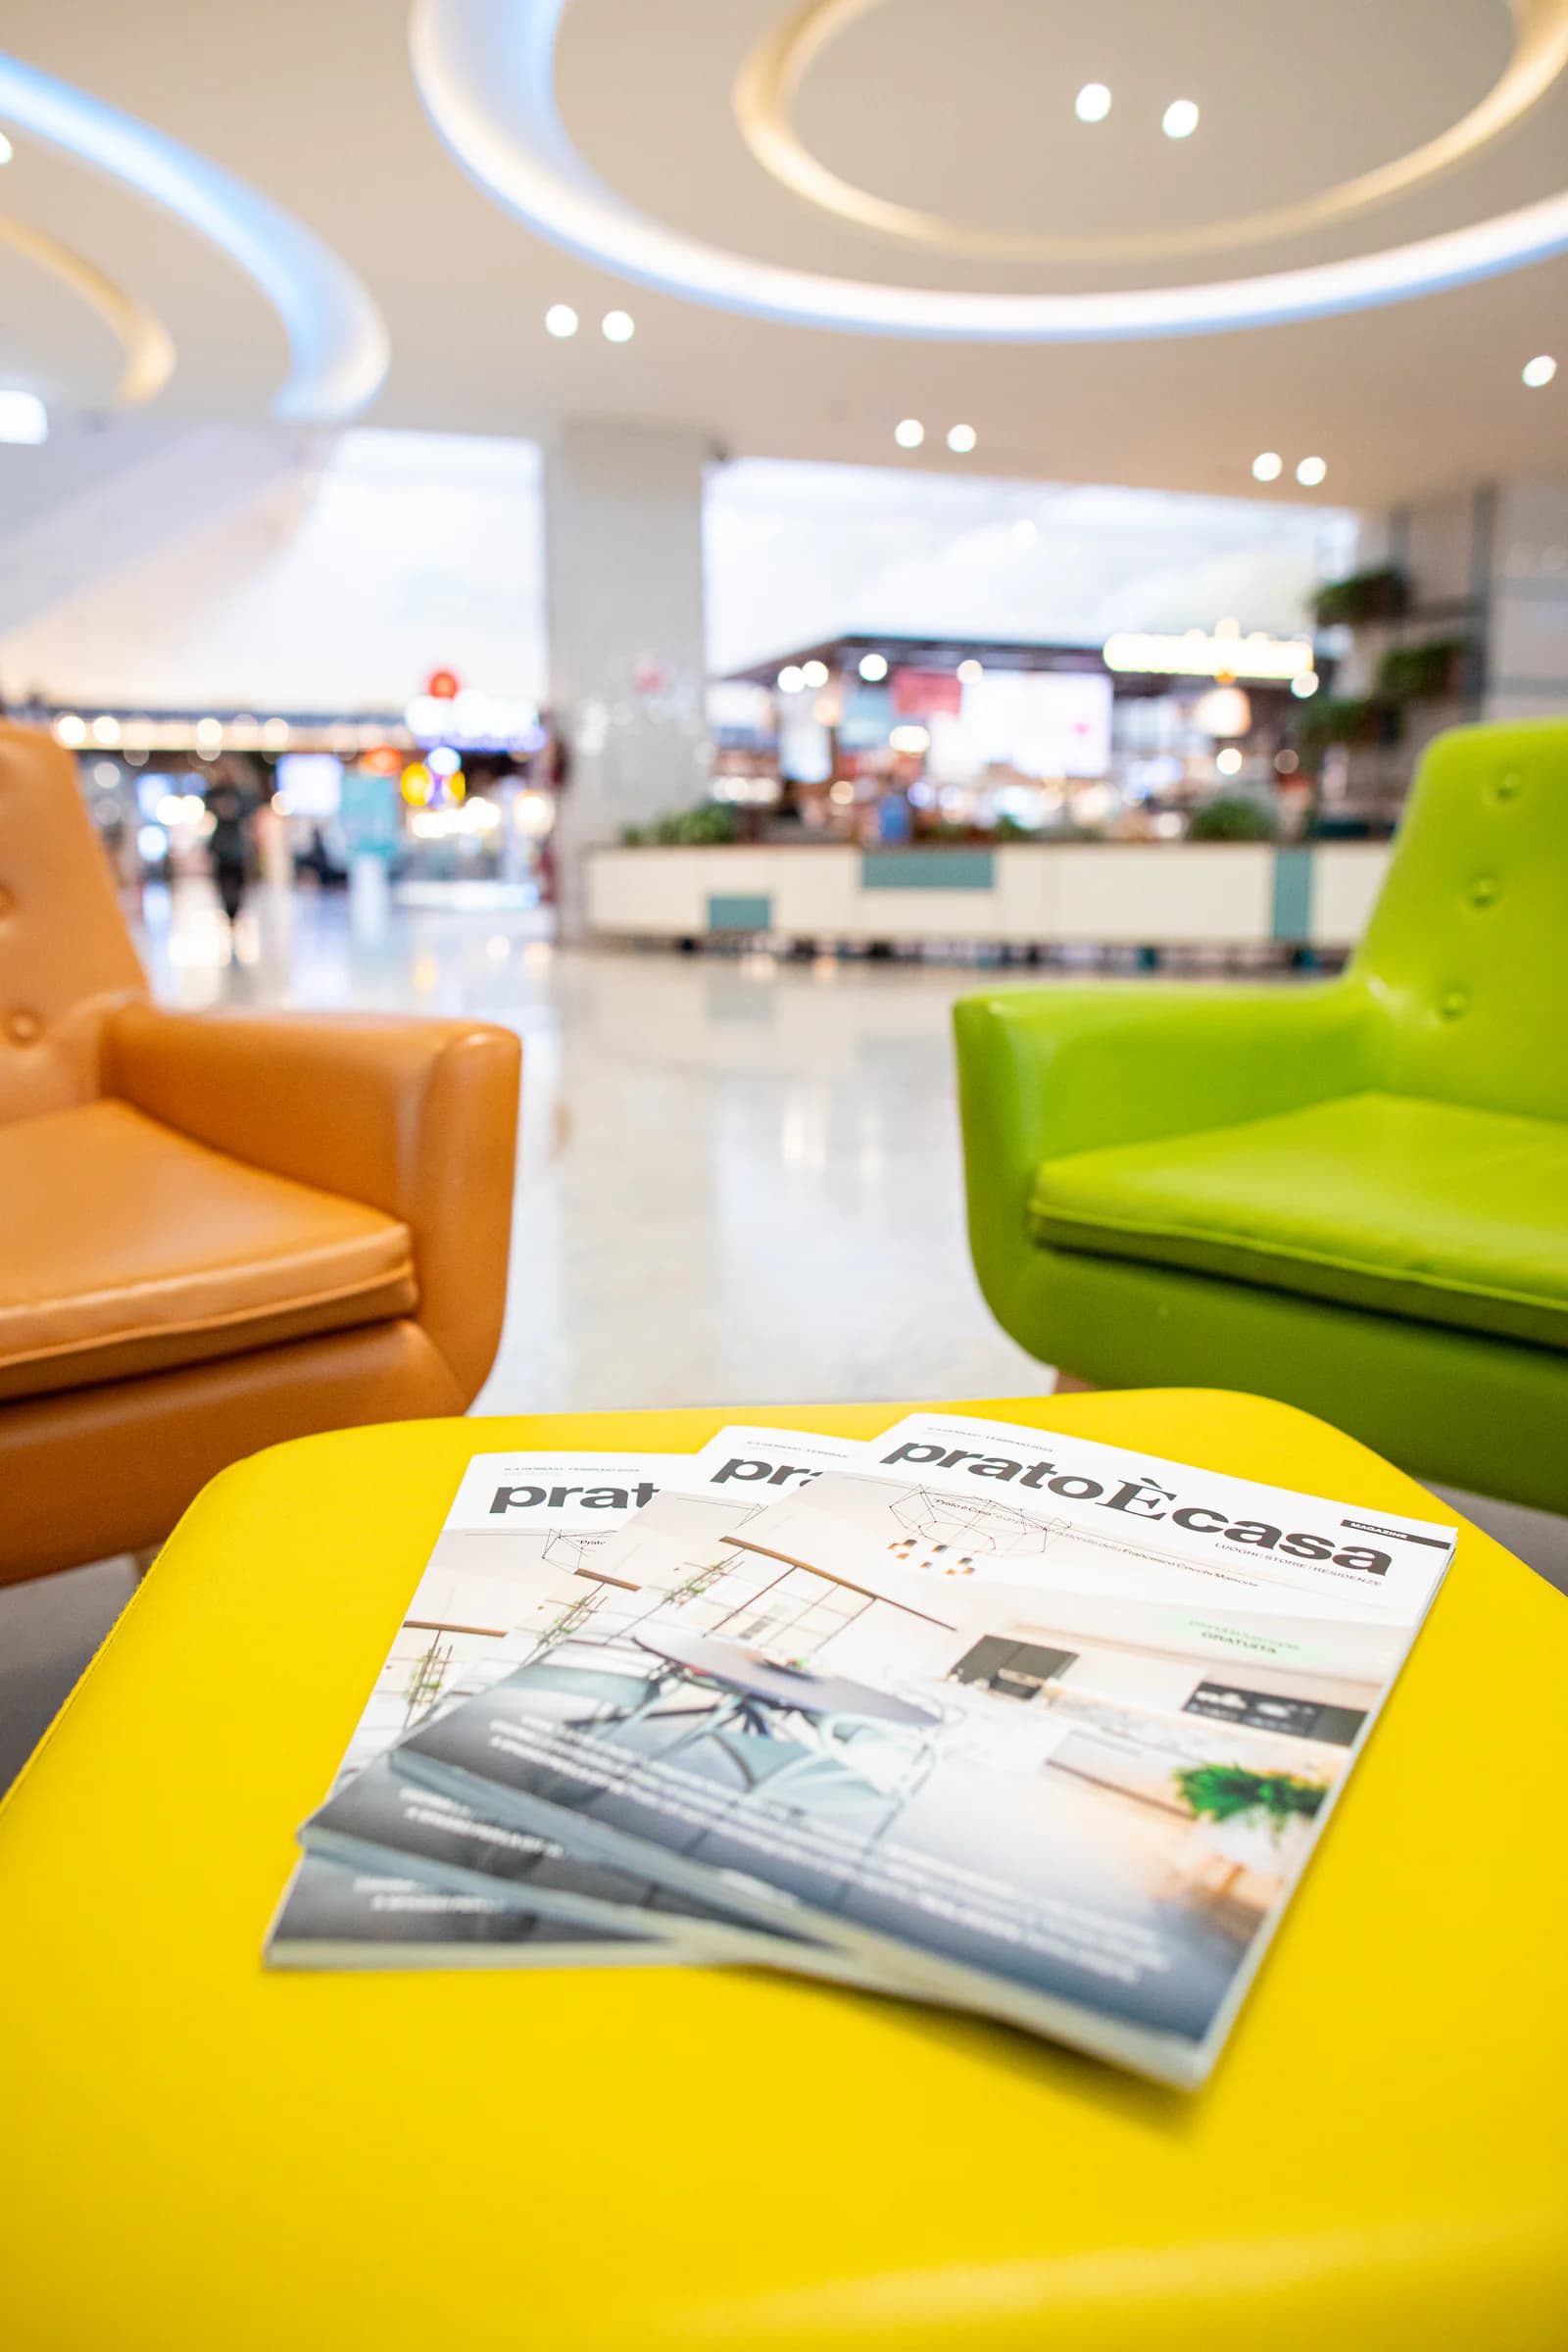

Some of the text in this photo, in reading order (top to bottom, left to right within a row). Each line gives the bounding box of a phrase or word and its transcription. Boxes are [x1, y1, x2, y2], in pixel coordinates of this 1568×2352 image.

[709, 1457, 824, 1488] pr
[1349, 1522, 1409, 1540] MAGAZINE
[1214, 1542, 1384, 1587] LUOGHI STORIE RESIDENZE
